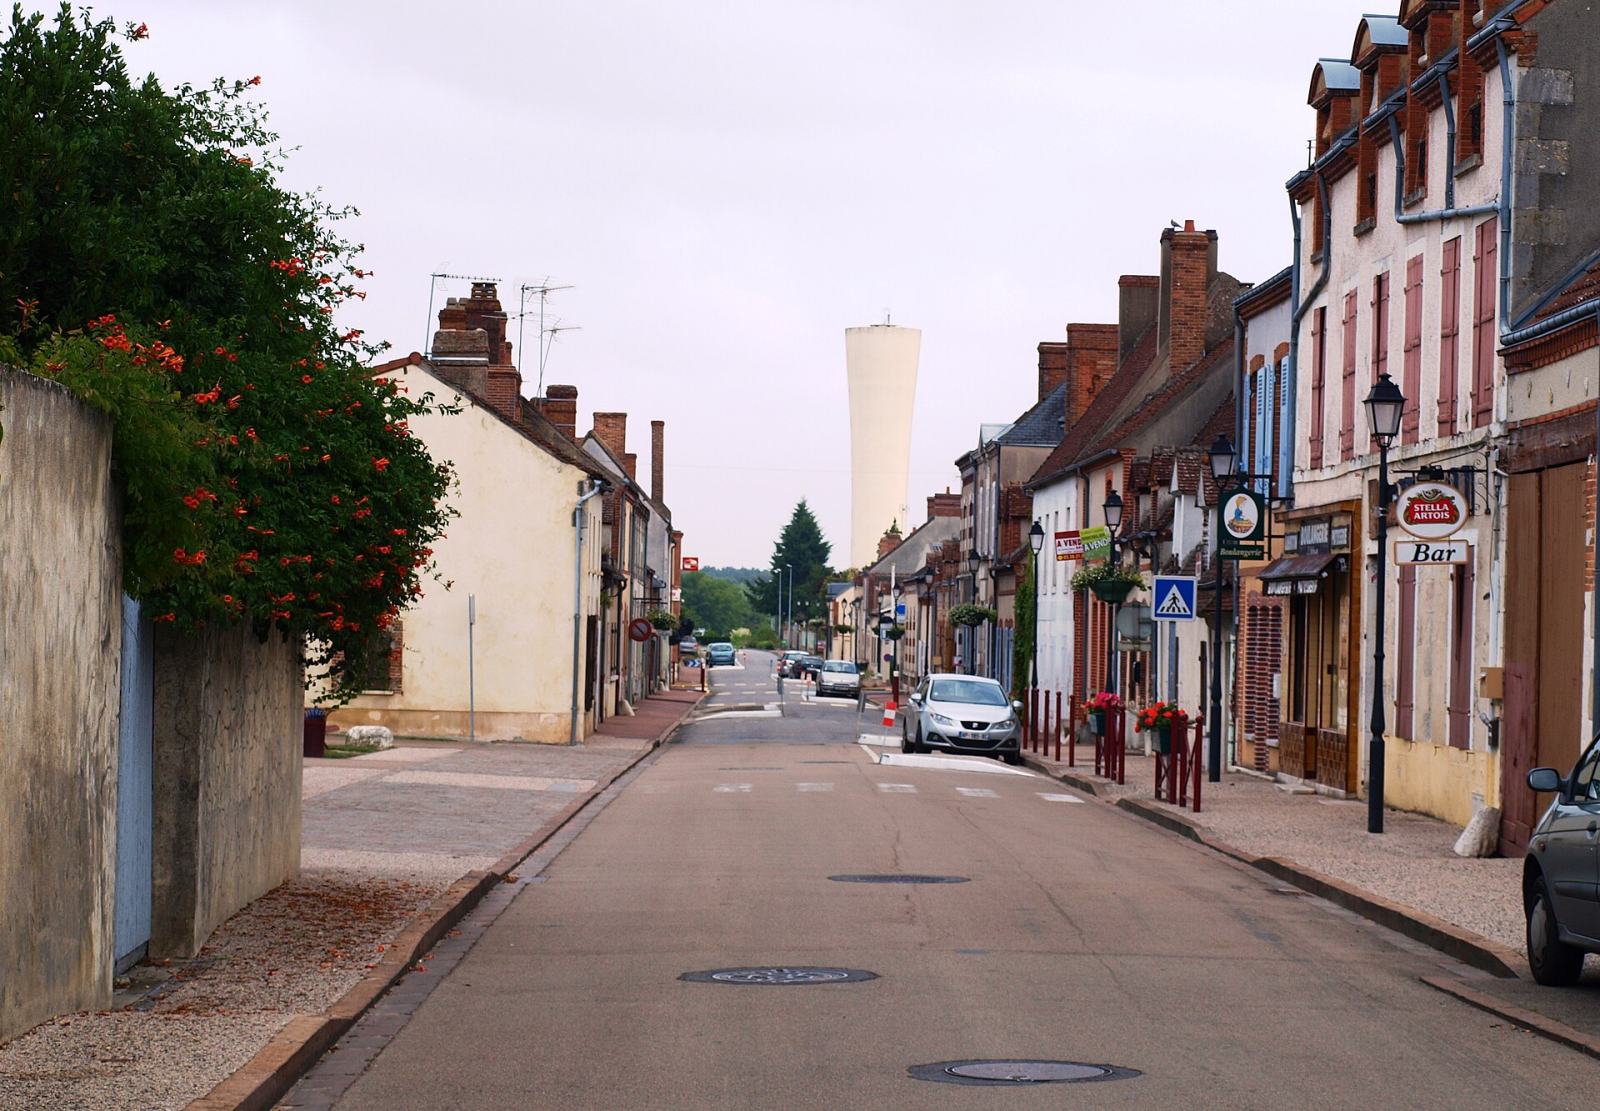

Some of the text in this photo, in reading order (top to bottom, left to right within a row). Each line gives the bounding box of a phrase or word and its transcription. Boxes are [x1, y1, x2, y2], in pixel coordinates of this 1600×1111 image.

[1413, 503, 1449, 511] STELLA
[1413, 511, 1450, 519] ARTOIS
[1220, 548, 1262, 557] Boulangerie
[1411, 543, 1456, 562] Bar
